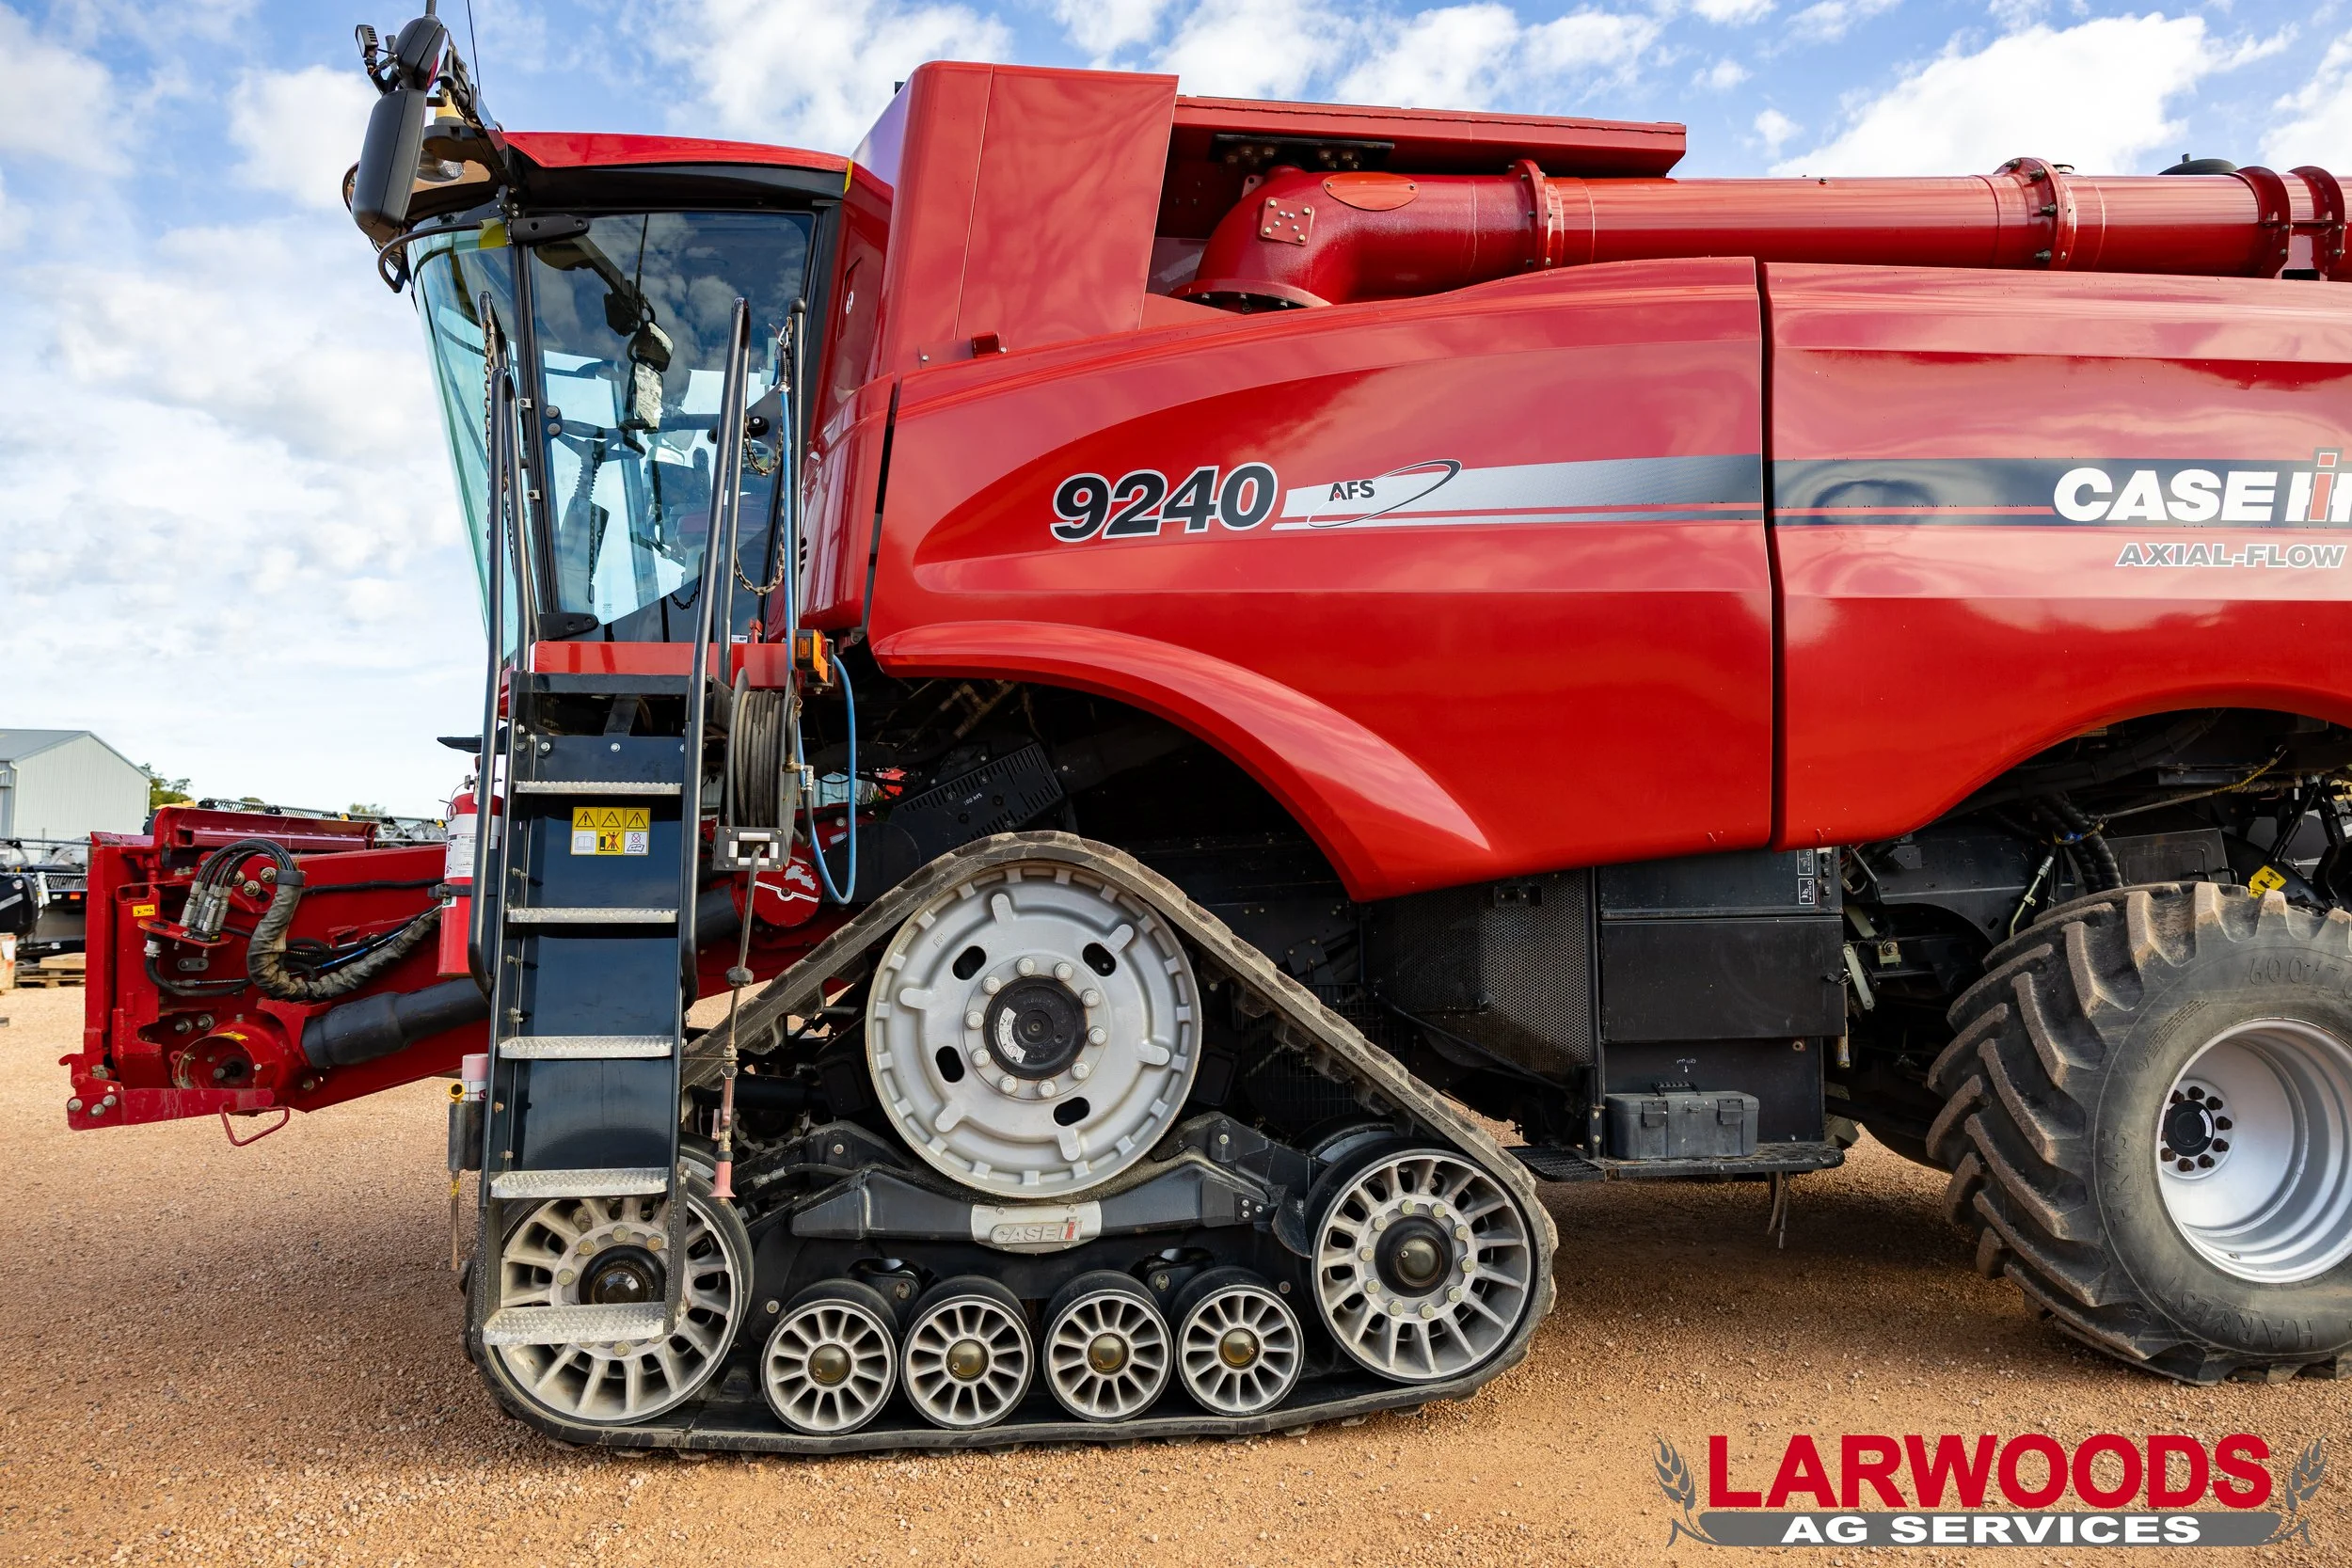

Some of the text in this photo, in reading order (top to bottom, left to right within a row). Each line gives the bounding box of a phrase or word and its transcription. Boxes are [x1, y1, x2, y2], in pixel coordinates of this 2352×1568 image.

[1050, 462, 1279, 543] 9240
[1328, 479, 1375, 502] AFS
[2054, 467, 2278, 522] CASE
[2114, 542, 2346, 568] AXIAL-FLOW
[991, 1225, 1056, 1243] CASE
